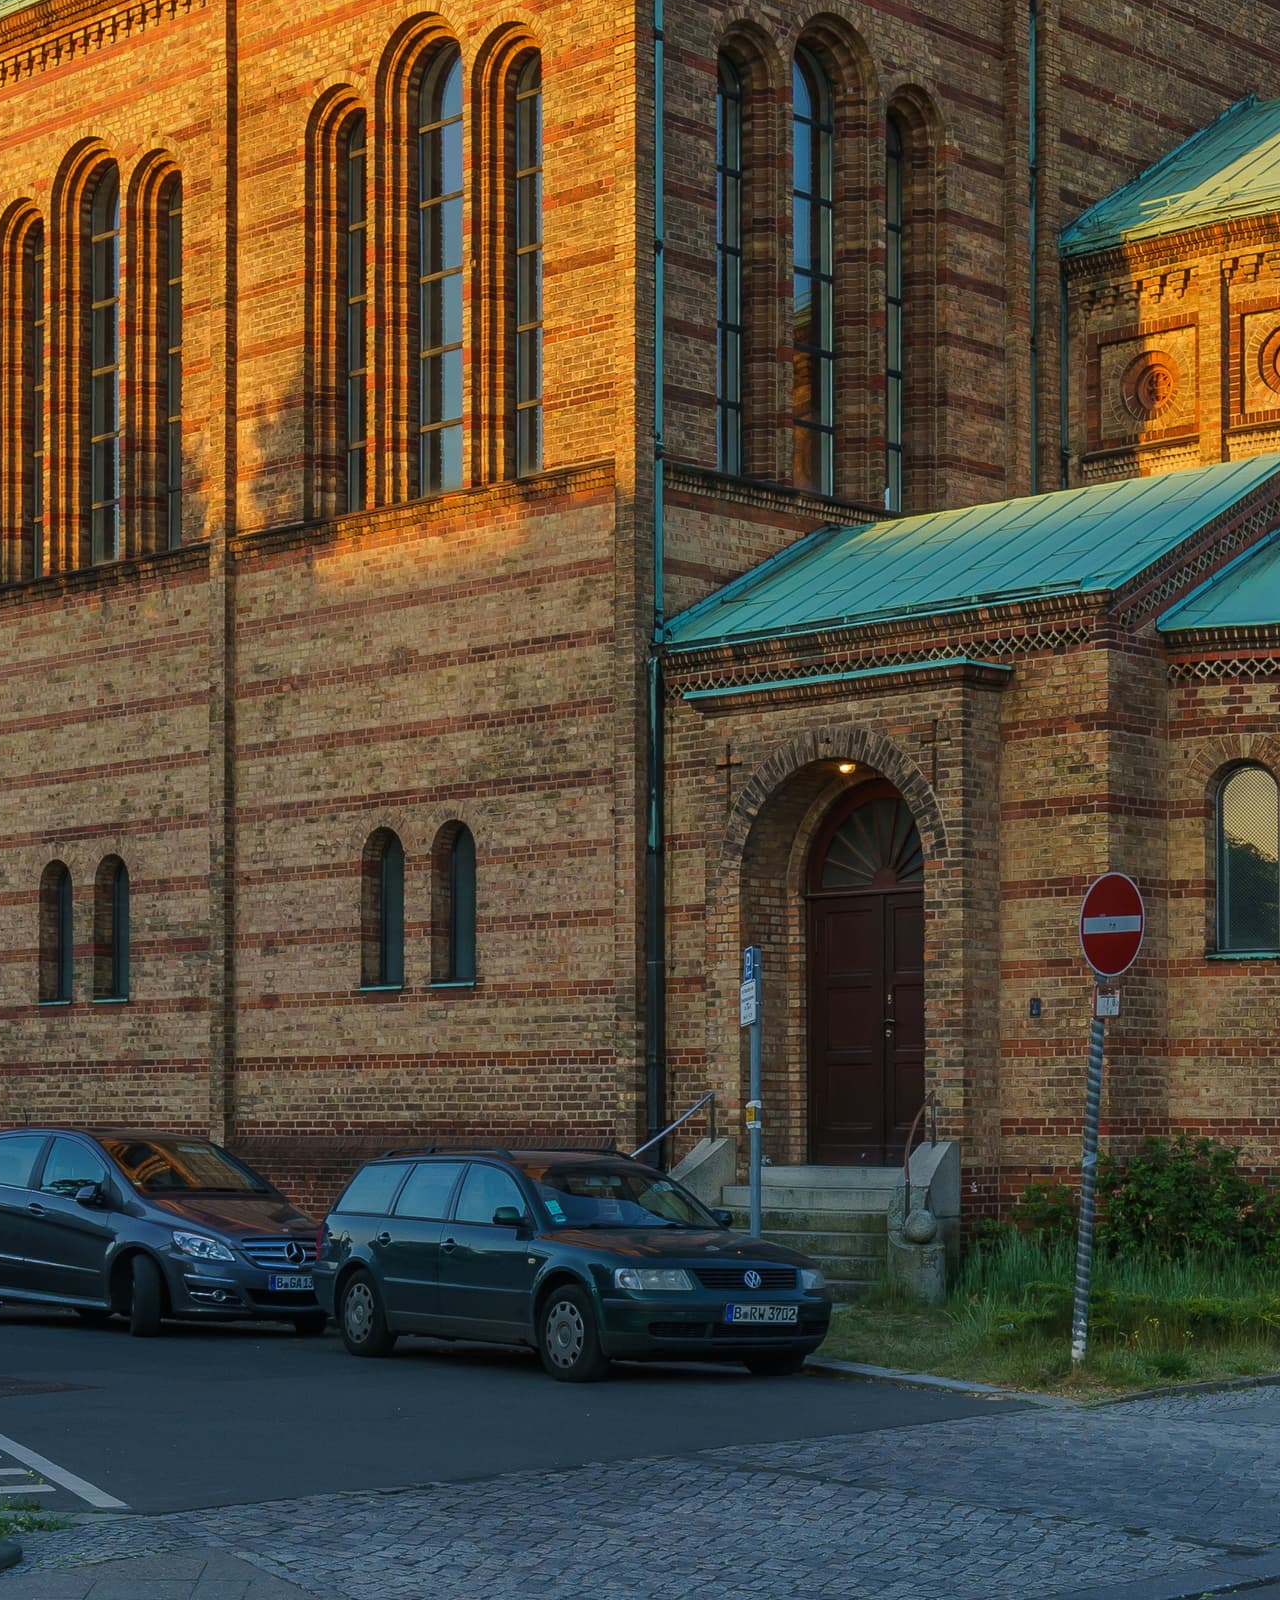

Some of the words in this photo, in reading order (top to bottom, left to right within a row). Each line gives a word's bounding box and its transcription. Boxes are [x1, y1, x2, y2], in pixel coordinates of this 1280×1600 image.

[277, 1277, 283, 1288] B
[734, 1306, 742, 1319] B
[750, 1307, 766, 1320] RW
[768, 1306, 796, 1320] 3702
